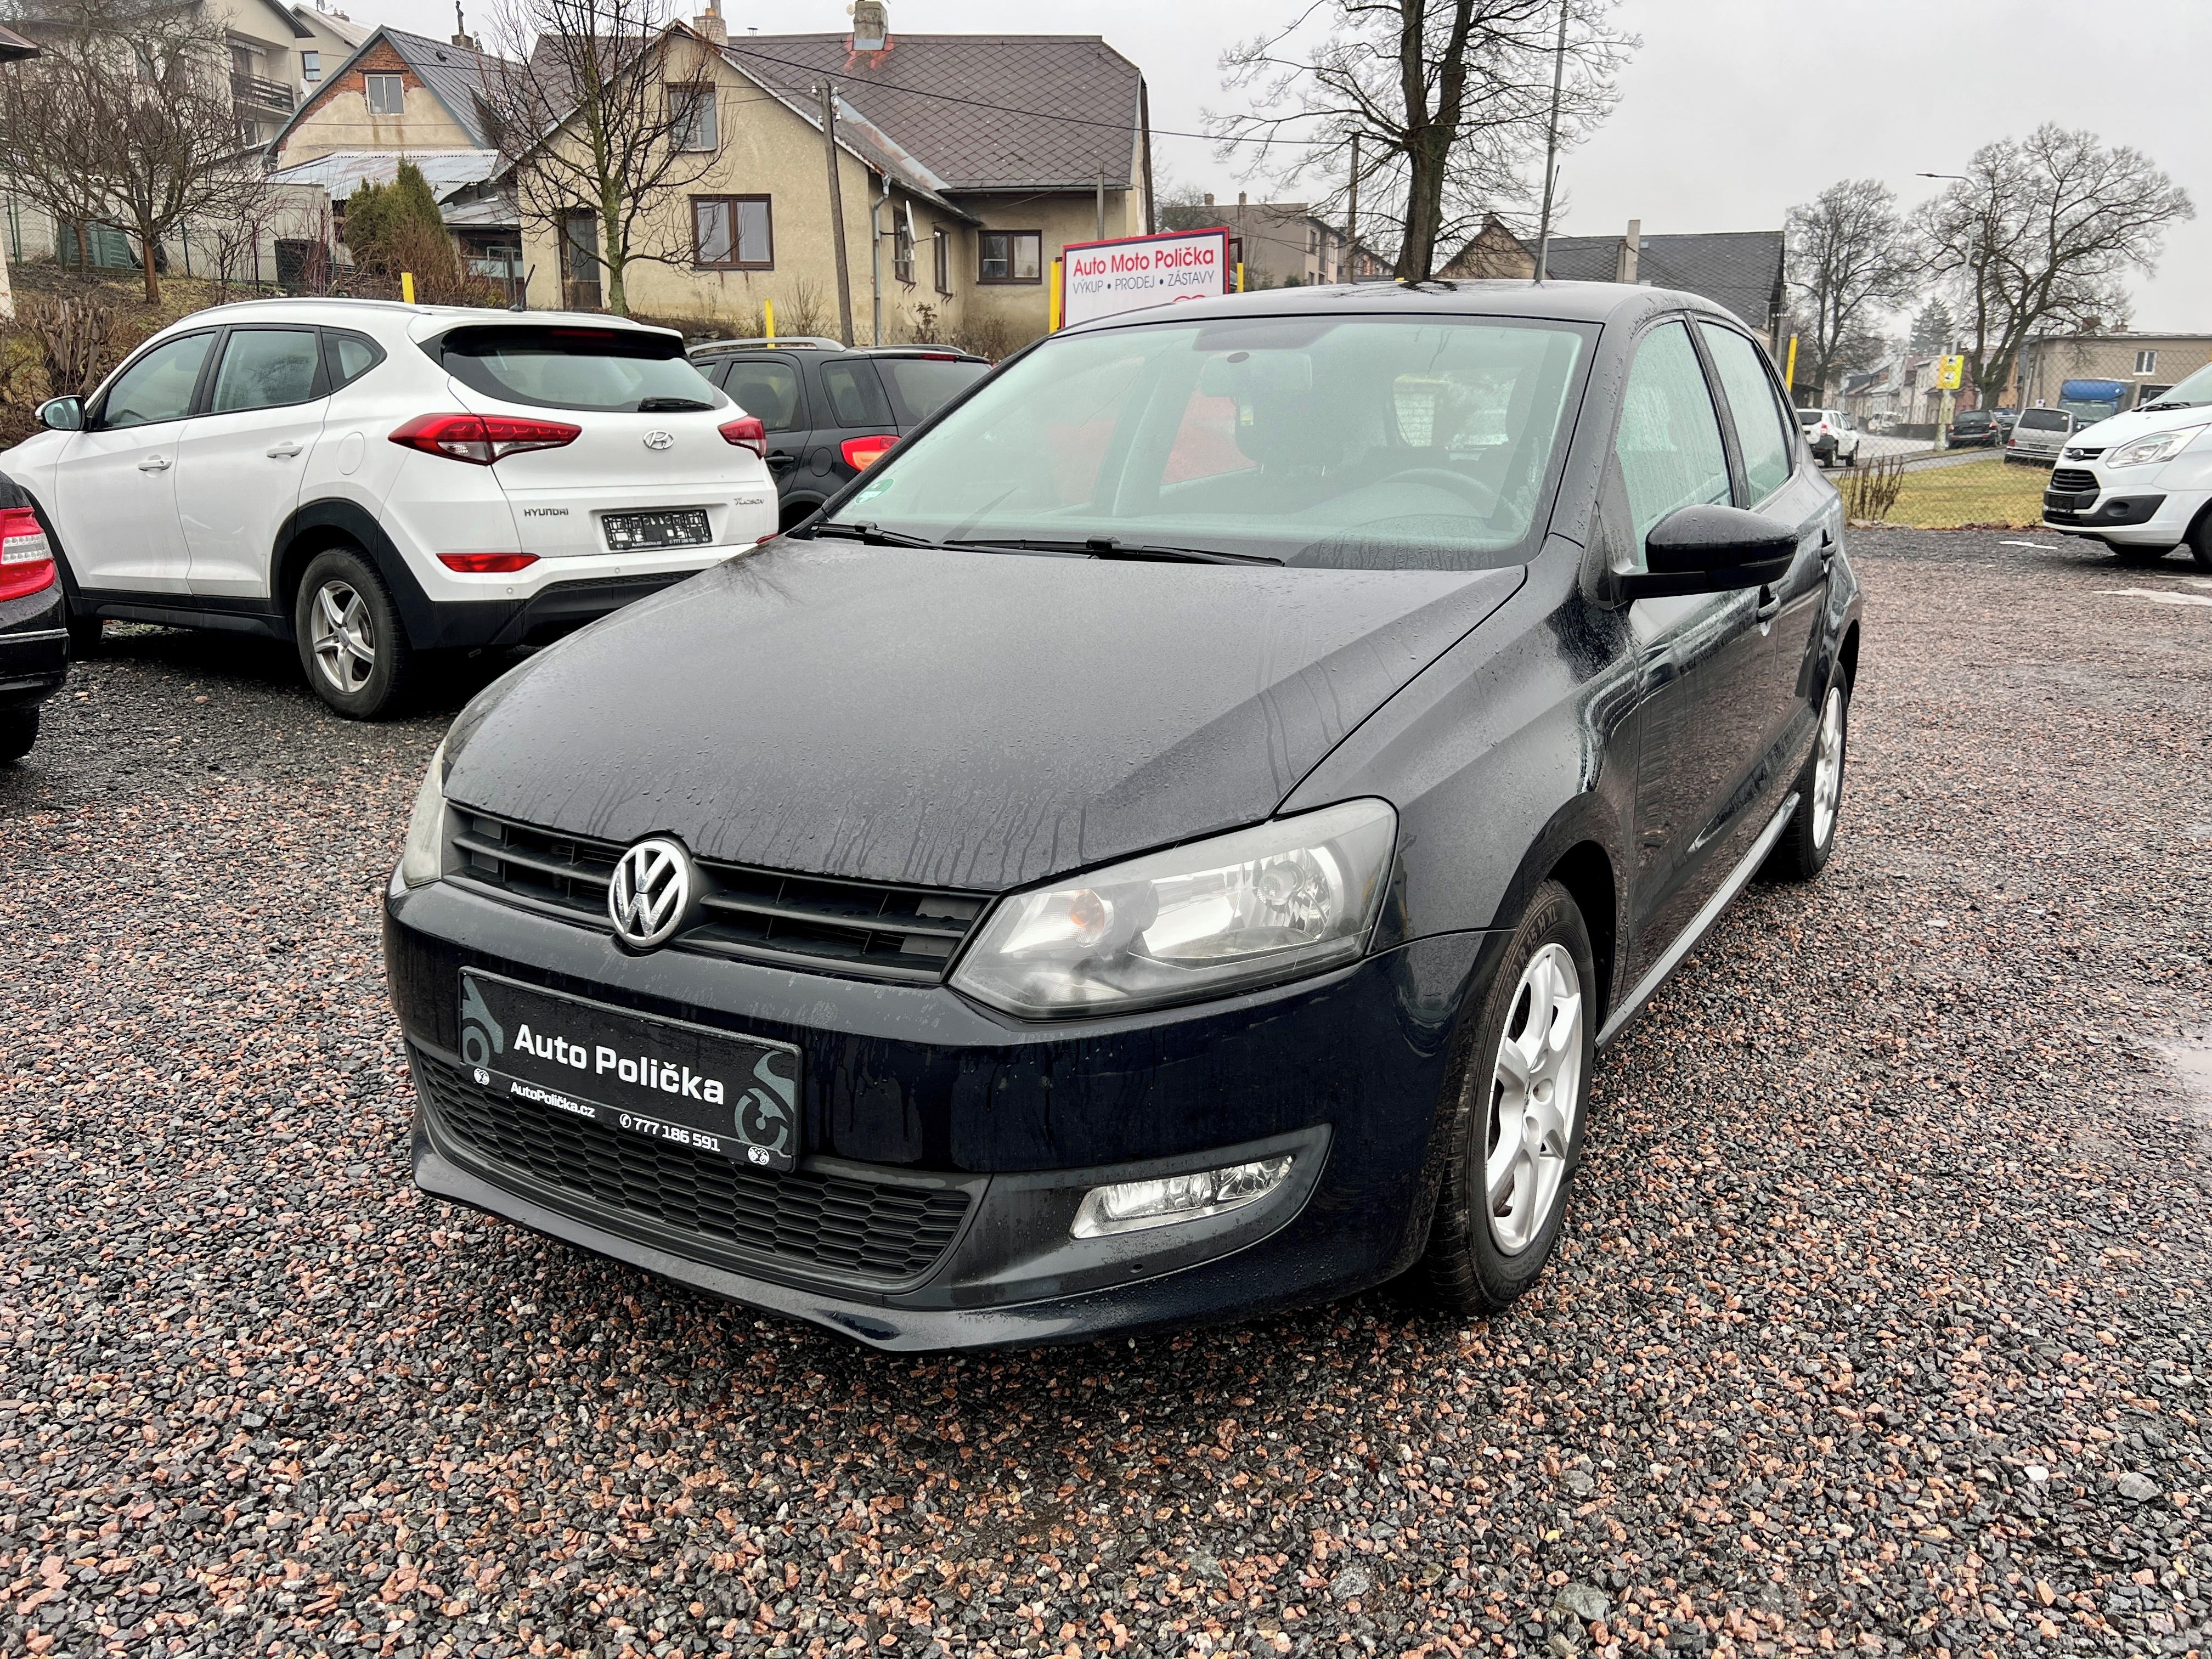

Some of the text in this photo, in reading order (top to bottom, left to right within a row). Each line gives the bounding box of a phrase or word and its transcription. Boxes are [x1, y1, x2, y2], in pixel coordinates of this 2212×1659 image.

[1073, 247, 1214, 276] Auto Moto Polička
[1073, 270, 1215, 294] VÝKUP PRODEJ ZÁSTAVY
[523, 508, 569, 516] HYUNDAI
[514, 1024, 724, 1105] Auto Polička
[511, 1082, 595, 1118] AutoPolička.cz
[633, 1117, 720, 1152] 777 186 591
